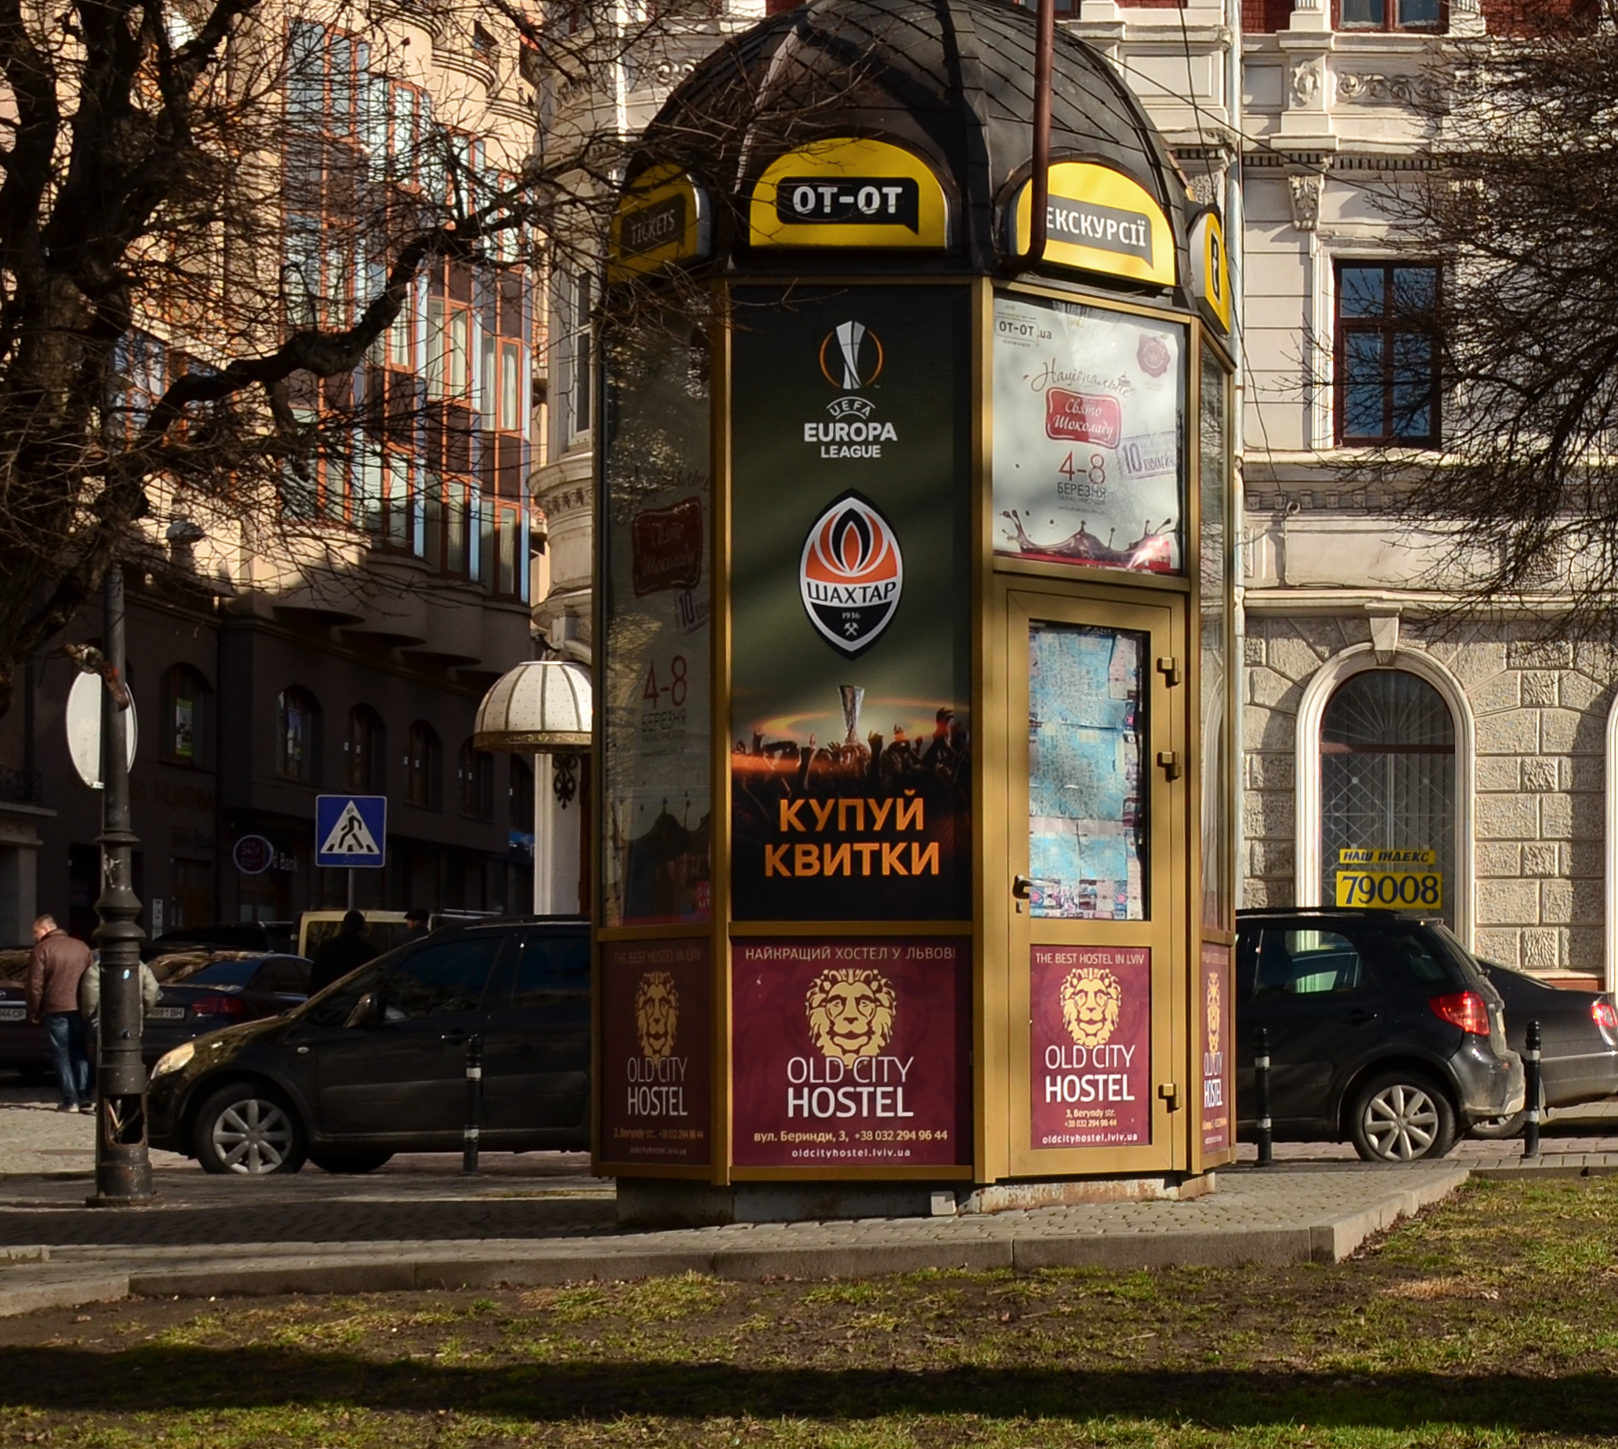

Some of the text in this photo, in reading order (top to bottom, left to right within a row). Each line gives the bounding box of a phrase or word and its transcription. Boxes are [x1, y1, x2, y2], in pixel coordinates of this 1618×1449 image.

[793, 186, 903, 214] ОТ-ОТ
[829, 400, 871, 417] UEFA
[1065, 398, 1102, 417] Свято
[804, 422, 898, 442] EUROPA
[1053, 414, 1115, 441] Шоколаду
[821, 445, 881, 458] LEAGUE
[1058, 450, 1106, 485] 4-8
[1057, 482, 1106, 499] БЕРЕЗНЯ
[807, 581, 897, 604] ШАХТАР
[643, 655, 687, 709] 4-8
[780, 789, 924, 832] КУПУЙ
[765, 842, 940, 877] КВИТКИ
[1343, 851, 1430, 863] НАШ ІНДЕКС
[1341, 875, 1439, 905] 79008
[745, 946, 956, 962] НАЙКРАЩИЙ ХОСТЕЛ У ЛЬВОВІ
[1036, 953, 1145, 965] THE BEST HOSTEL IN LVIV
[1045, 1044, 1136, 1069] OLD CITY
[627, 1056, 689, 1082] OLD CITY
[787, 1056, 914, 1083] OLD CITY
[1045, 1074, 1136, 1103] HOSTEL
[627, 1086, 689, 1116] HOSTEL
[787, 1086, 914, 1118] HOSTEL
[1073, 1109, 1104, 1118] Beryndy
[754, 1130, 948, 1143] вул. Беринди, 3, +38 032 294 96 44
[1042, 1133, 1138, 1144] oldcityhostel.lviv.ua
[791, 1148, 911, 1158] oldcityhostel.lviv.ua
